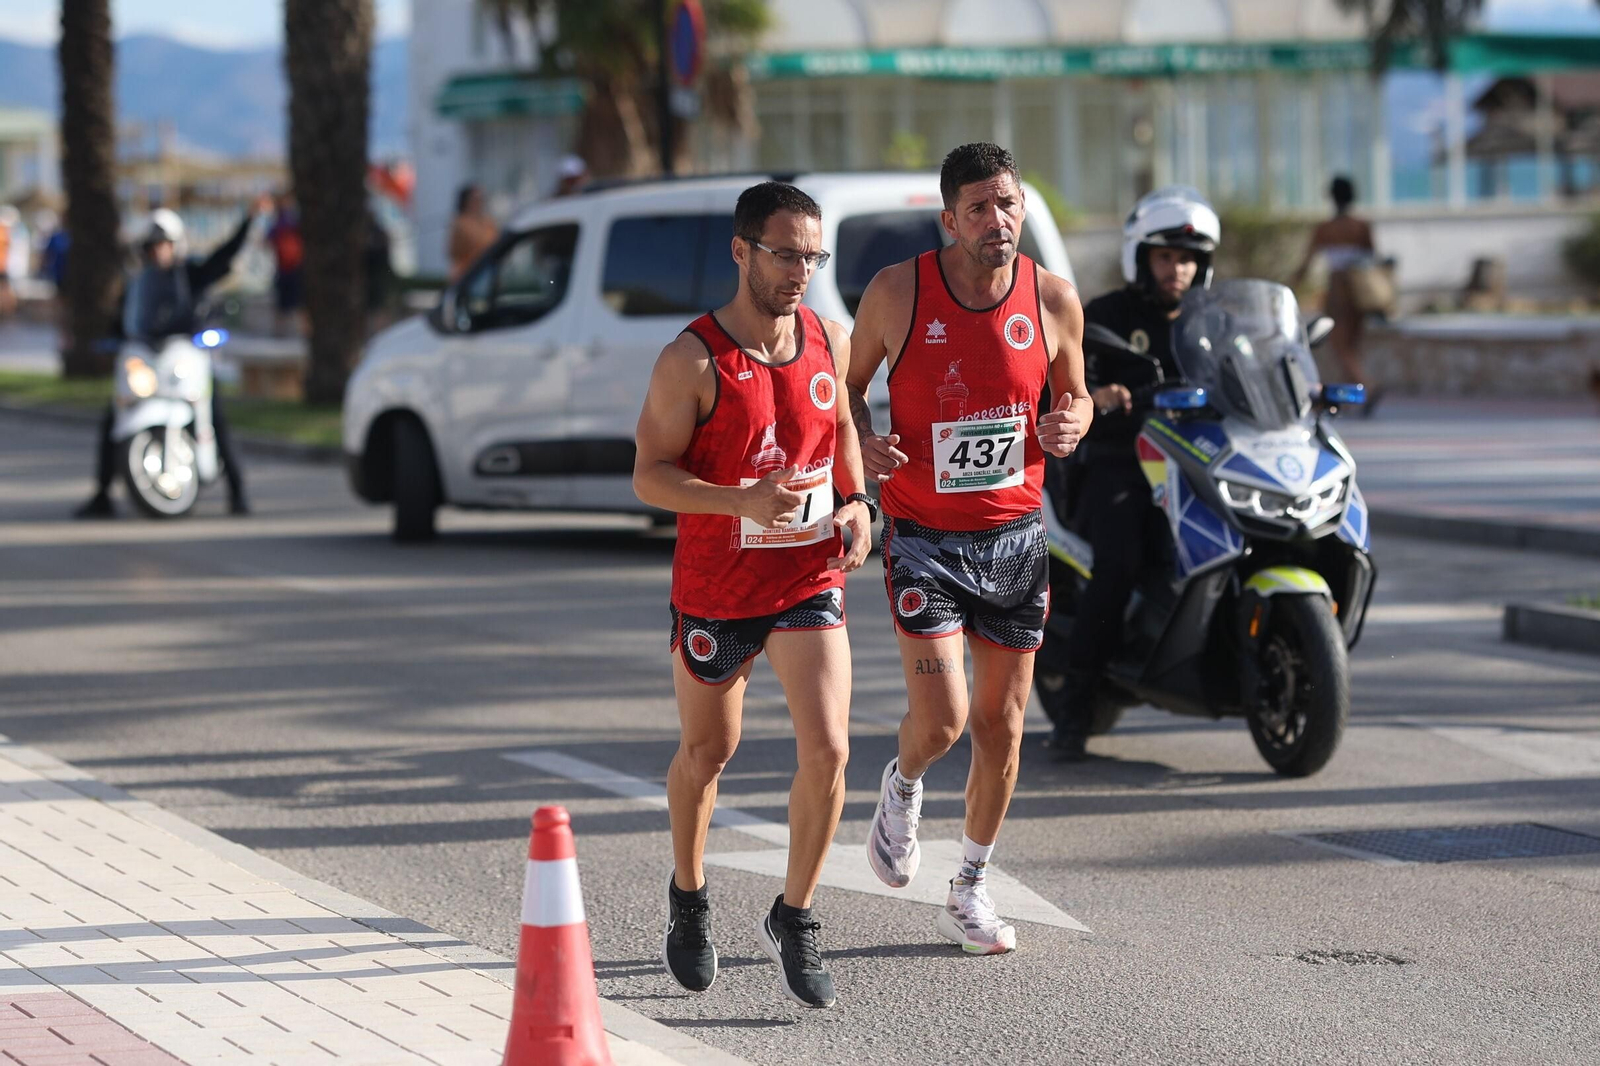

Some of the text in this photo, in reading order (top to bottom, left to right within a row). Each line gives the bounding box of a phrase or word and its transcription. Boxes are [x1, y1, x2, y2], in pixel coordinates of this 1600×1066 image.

[957, 401, 1032, 422] CORREDORES
[948, 436, 1016, 470] 437
[941, 480, 956, 488] 024
[746, 536, 763, 544] 024
[914, 658, 957, 675] ALBA
